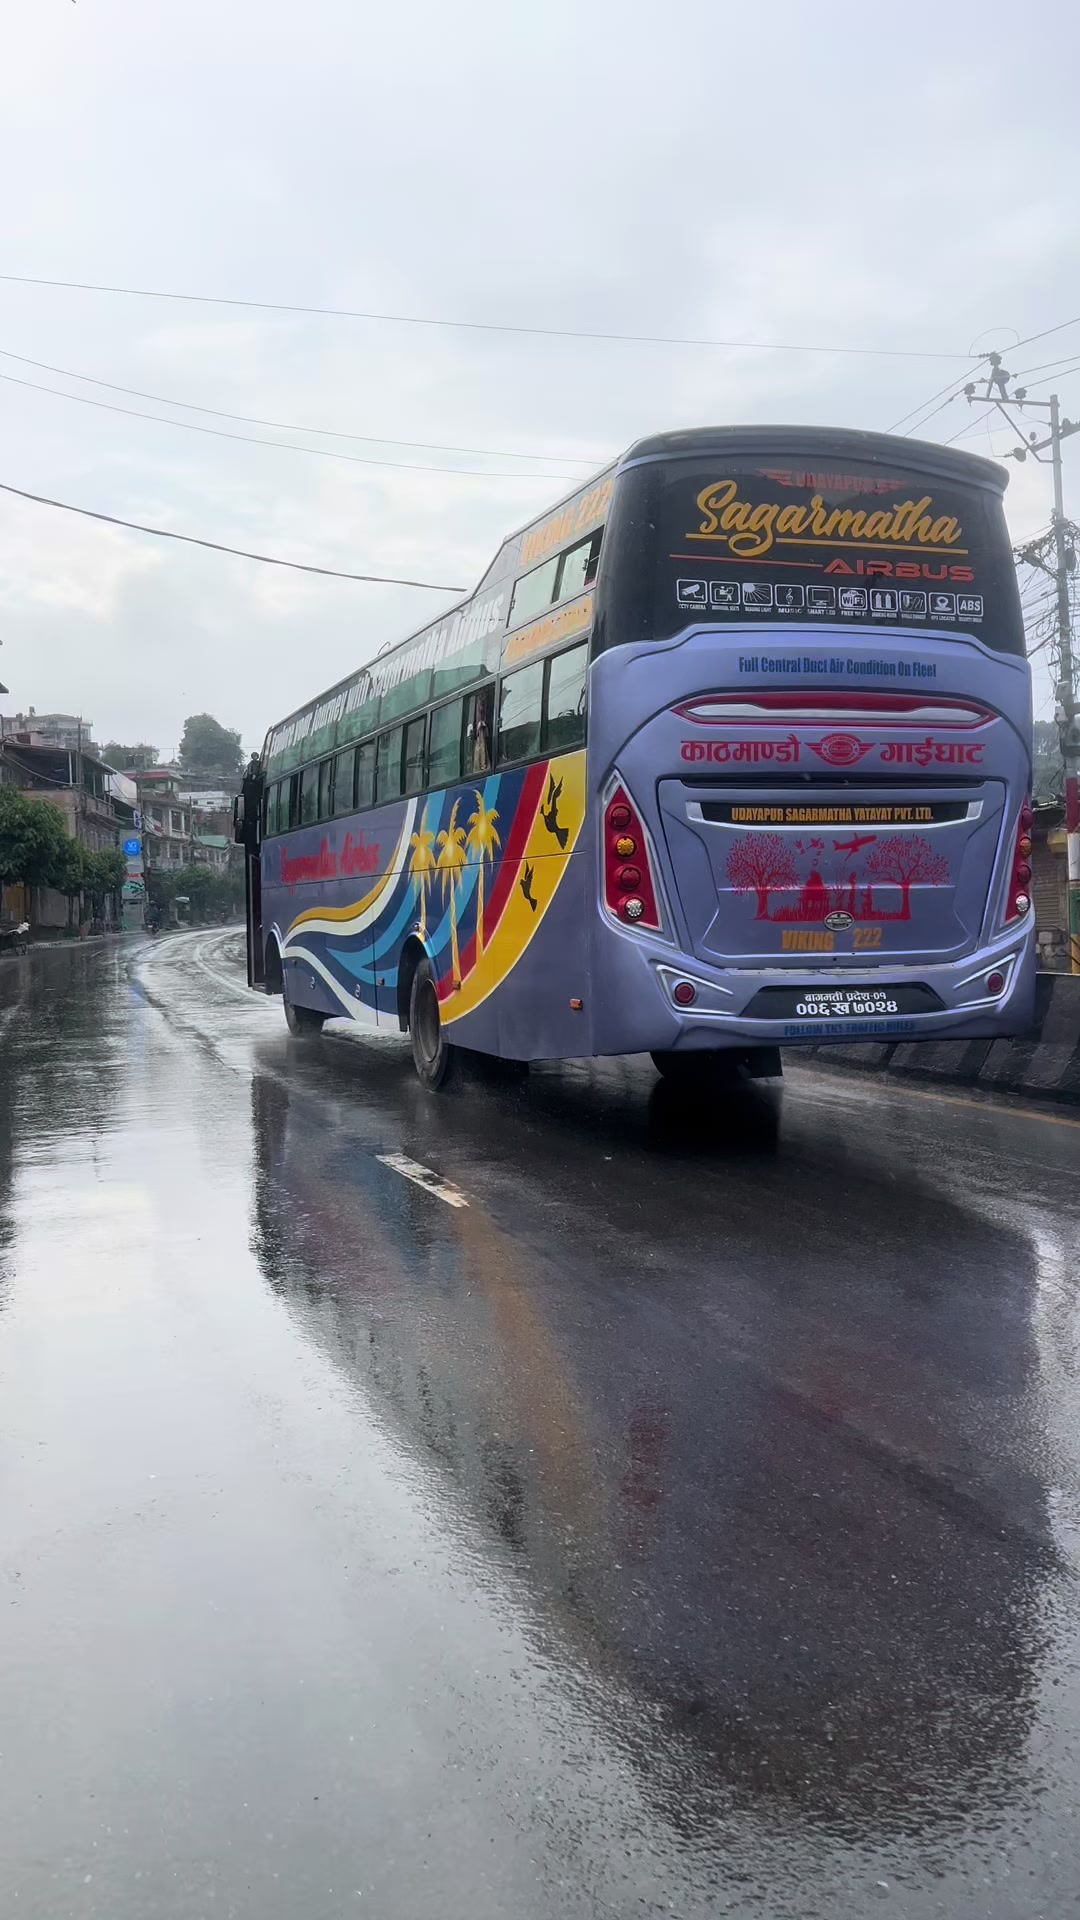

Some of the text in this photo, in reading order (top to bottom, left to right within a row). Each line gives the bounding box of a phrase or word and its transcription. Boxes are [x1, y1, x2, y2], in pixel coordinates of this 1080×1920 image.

[697, 479, 962, 556] Sagarmatha
[823, 558, 975, 582] AIRBUS
[960, 600, 981, 611] ABS
[739, 656, 937, 678] Full Central Duct Air Condition On Fleet
[680, 733, 801, 763] काठमाण्डौ
[879, 737, 986, 767] गाईघाट
[731, 807, 934, 821] UDAYAPUR SAGARMATHA YATAYAT PVT. LTD.
[782, 928, 882, 951] VIKING 222
[804, 991, 843, 1002] बागमती
